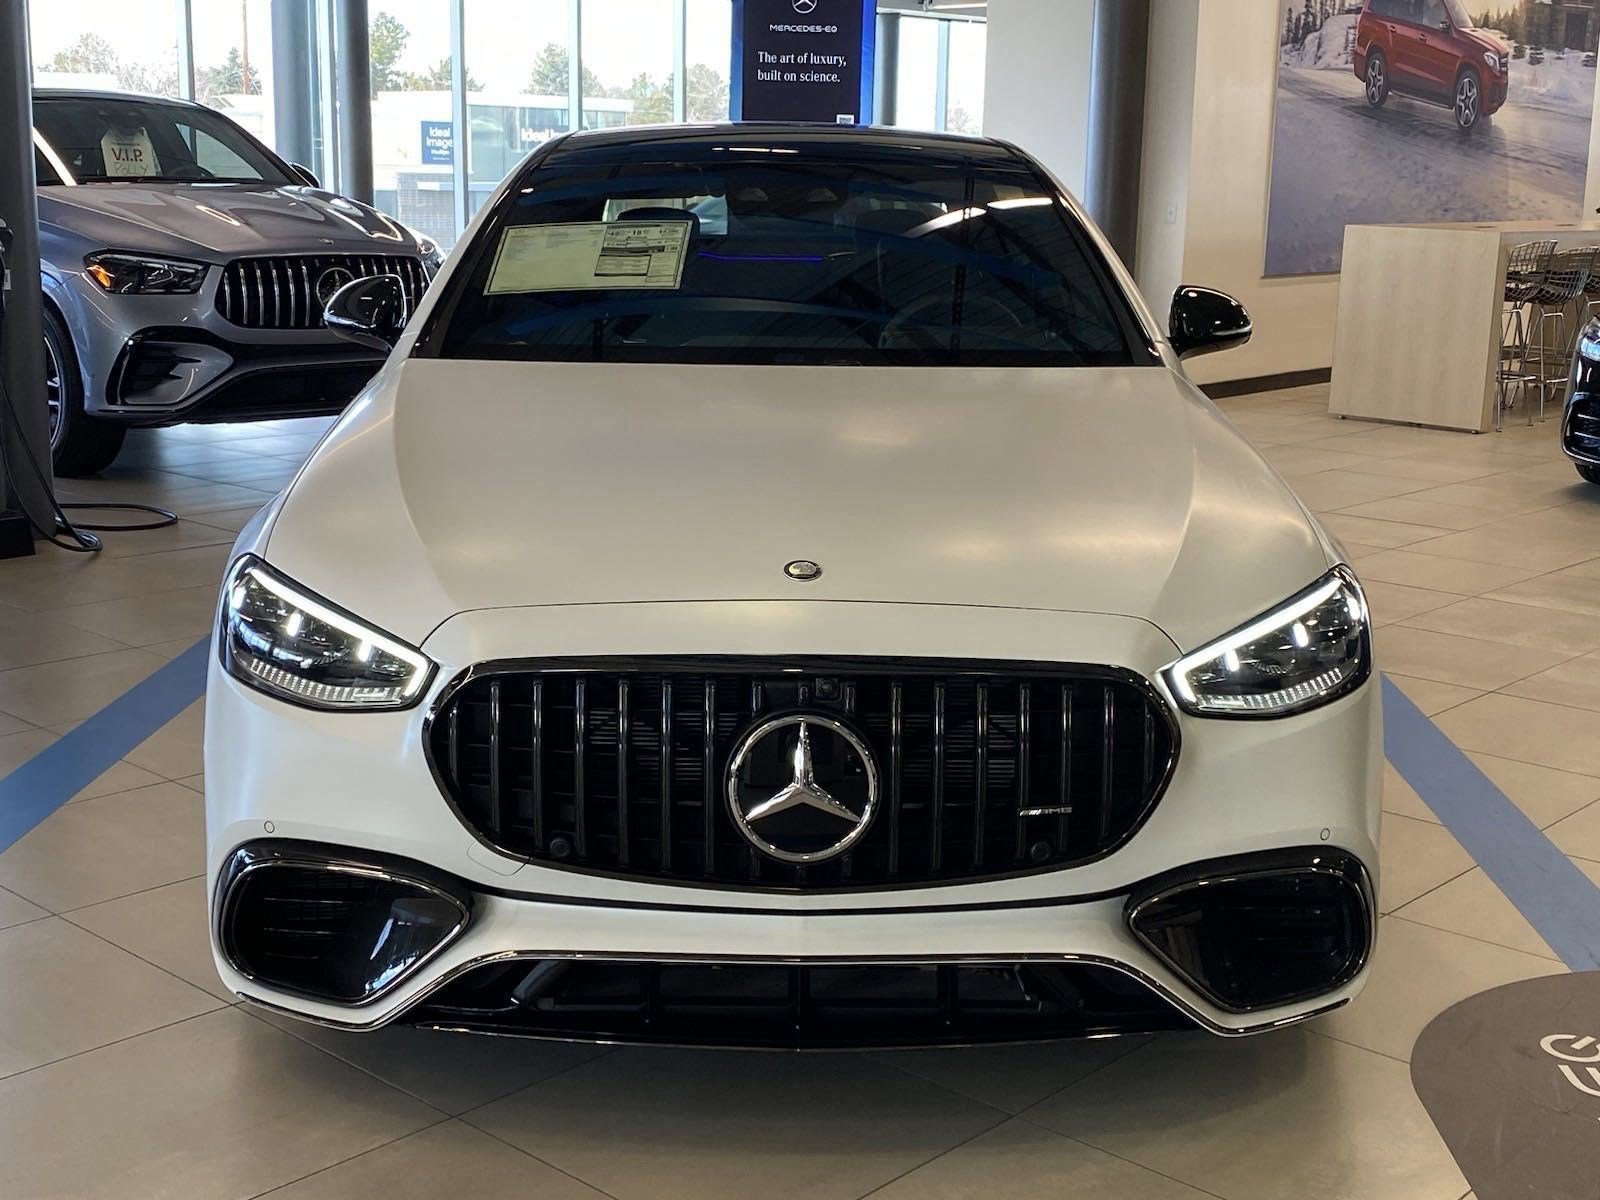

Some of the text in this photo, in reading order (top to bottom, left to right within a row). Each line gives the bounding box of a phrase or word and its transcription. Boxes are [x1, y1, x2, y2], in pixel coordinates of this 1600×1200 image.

[769, 24, 838, 33] MERCEDES-EQ
[757, 51, 847, 67] The art of luxury,
[757, 69, 841, 82] built on science.
[429, 127, 451, 137] Ideal
